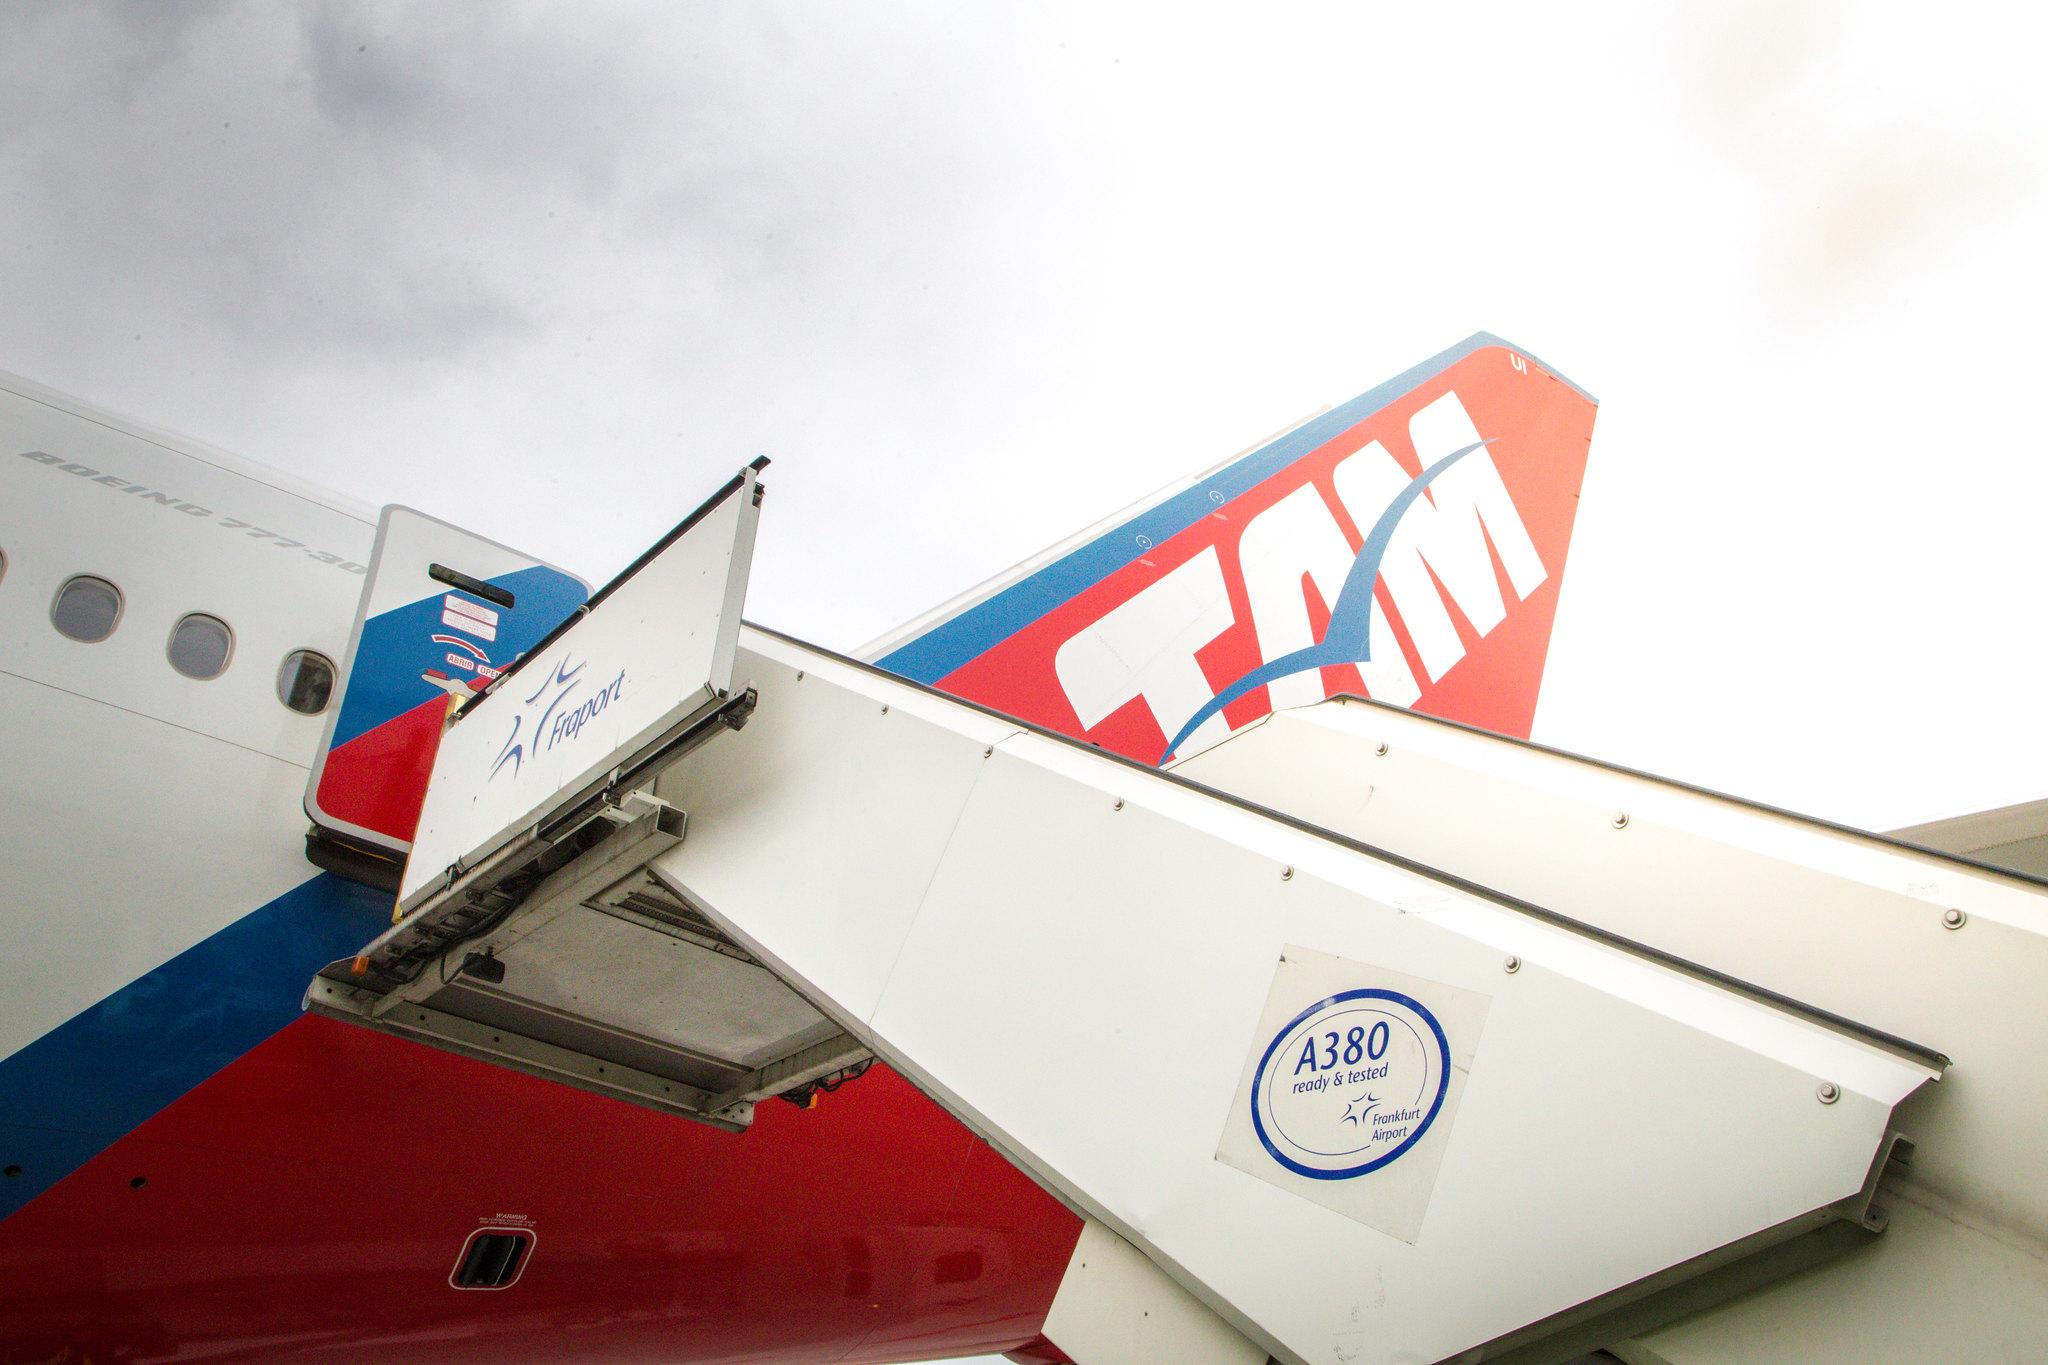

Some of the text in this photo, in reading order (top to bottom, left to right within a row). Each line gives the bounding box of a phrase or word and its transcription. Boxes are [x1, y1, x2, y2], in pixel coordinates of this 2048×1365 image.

[18, 451, 213, 517] BOEING
[1055, 389, 1549, 770] TAM
[448, 655, 473, 669] ABRIR
[548, 668, 626, 751] Fraport
[1294, 1022, 1390, 1075] A380
[1292, 1062, 1389, 1094] ready & tested
[1372, 1126, 1407, 1142] Airport
[1373, 1108, 1420, 1125] Frankfurt
